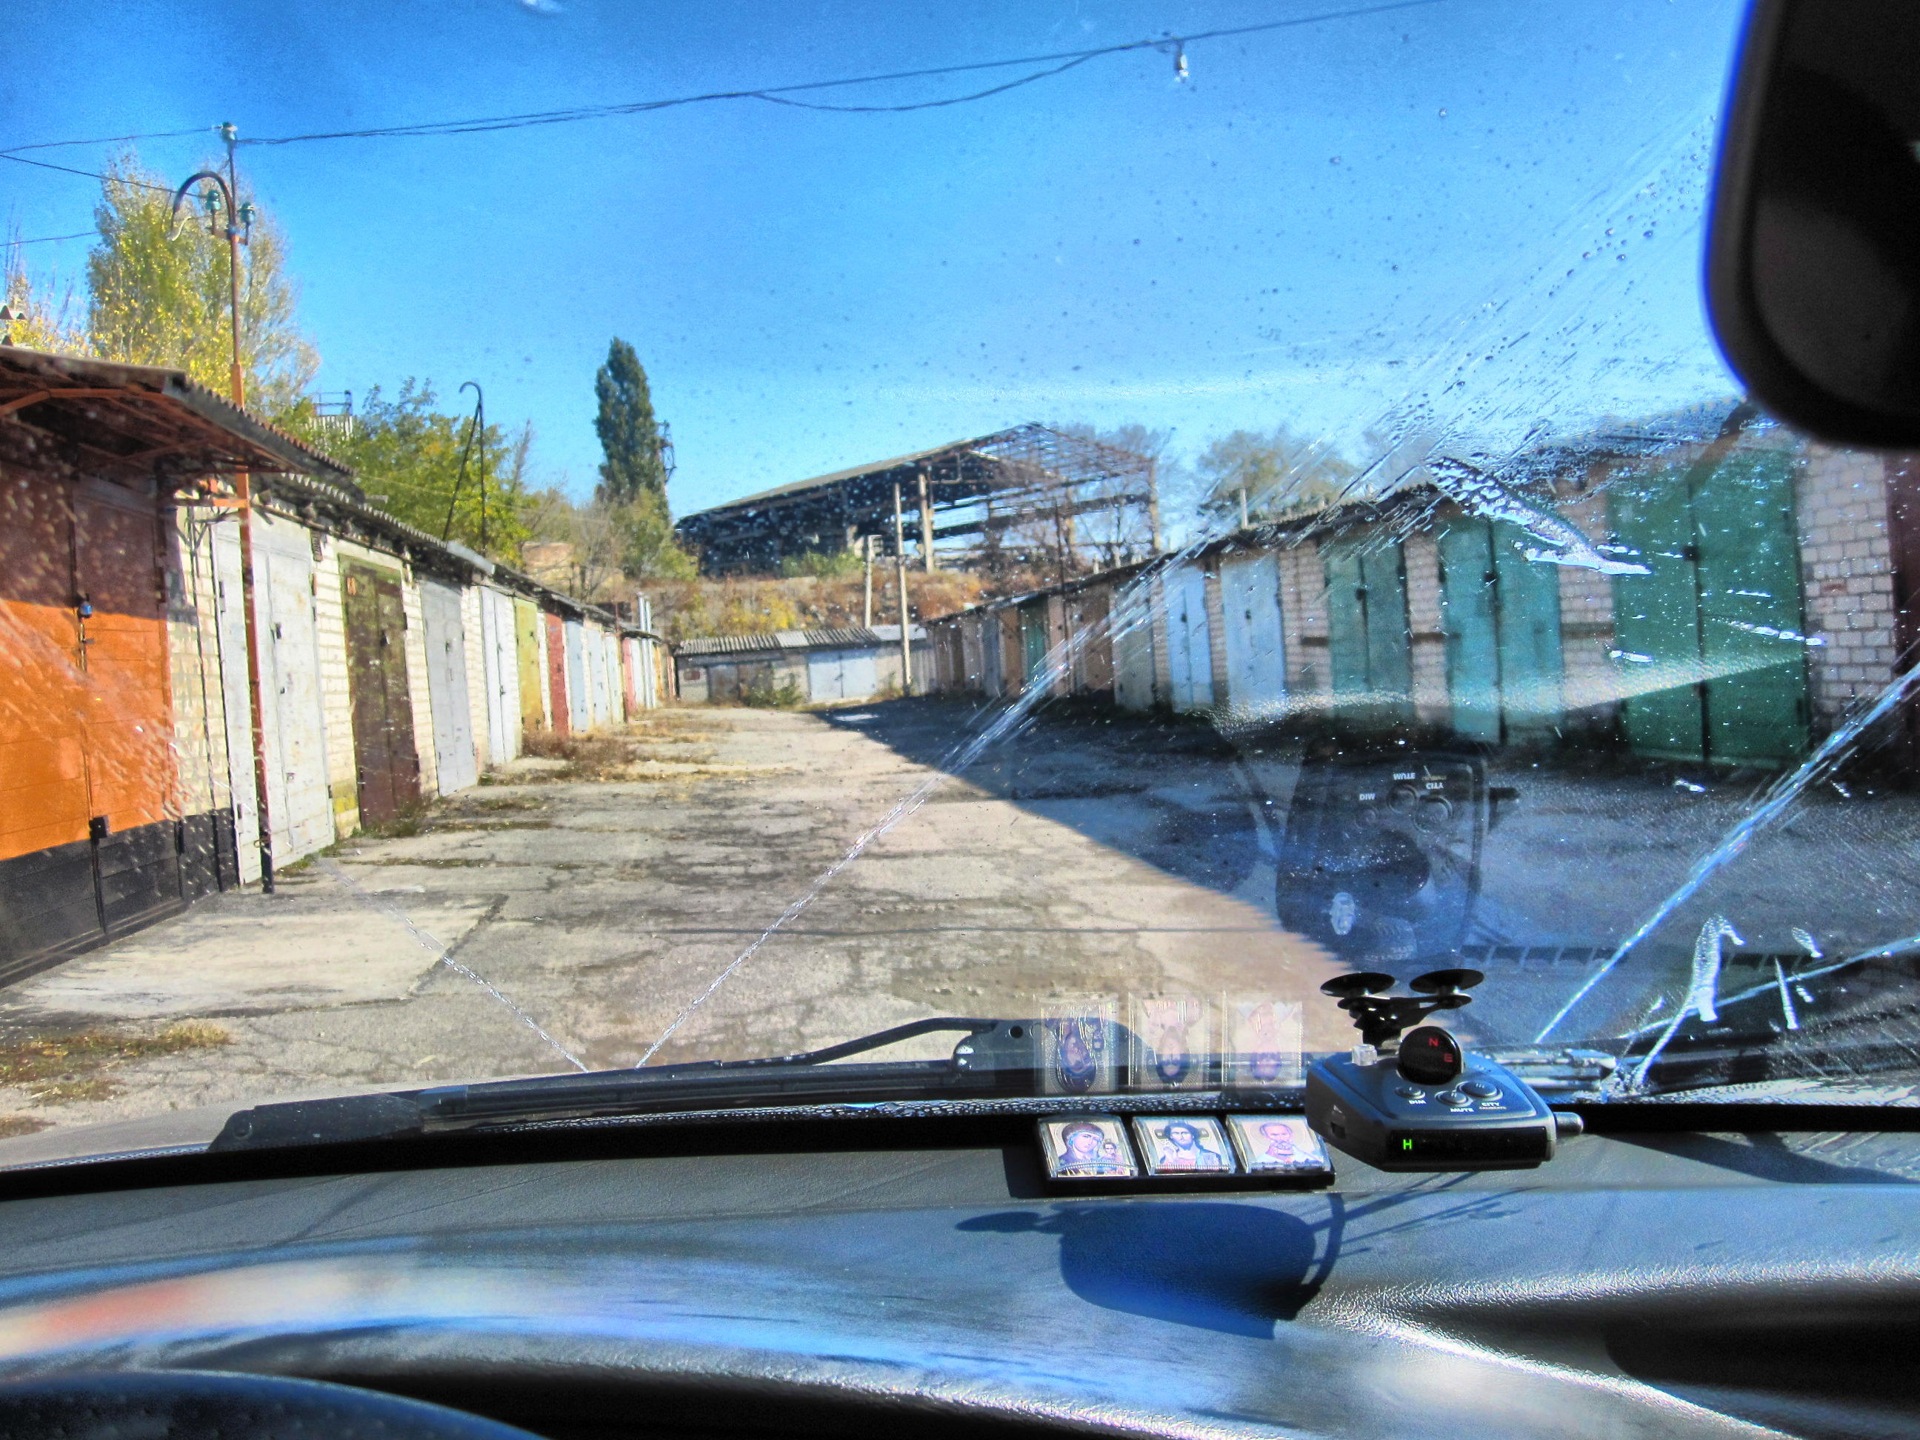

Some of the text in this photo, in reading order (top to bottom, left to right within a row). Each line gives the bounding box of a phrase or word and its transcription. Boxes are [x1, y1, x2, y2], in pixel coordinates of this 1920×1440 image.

[1429, 1038, 1439, 1047] N
[1444, 1054, 1453, 1062] E
[1403, 1139, 1413, 1150] H
